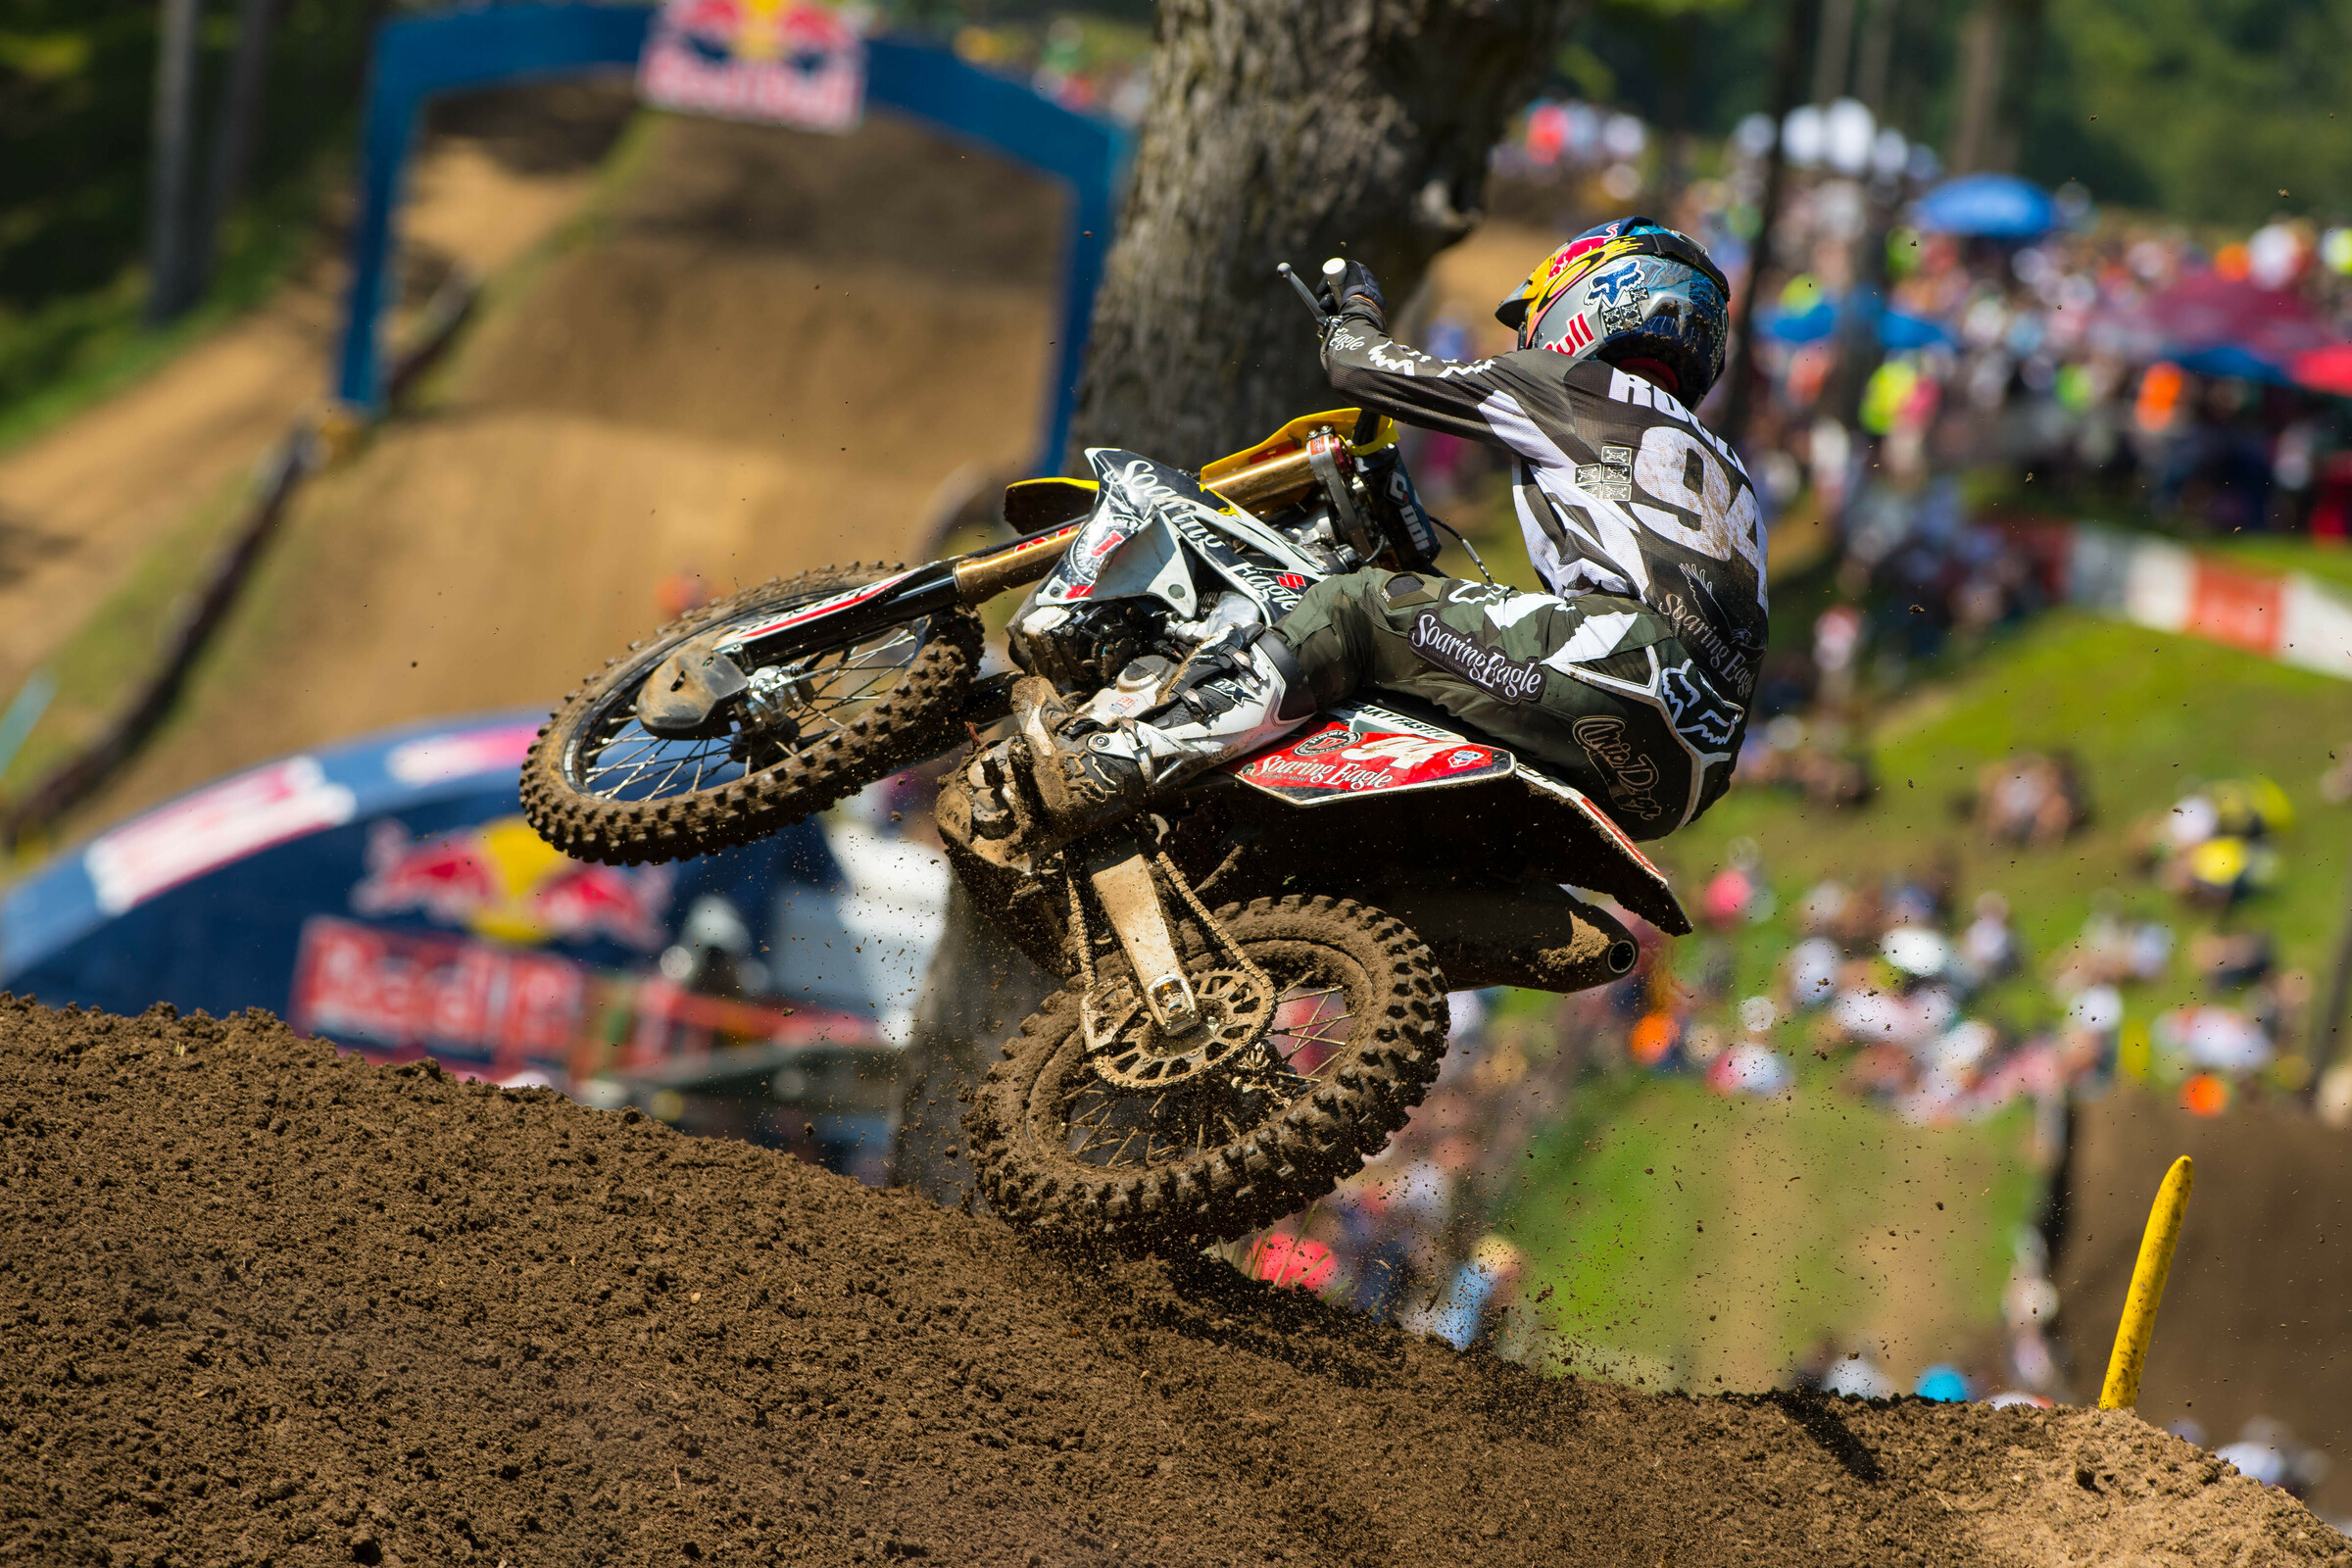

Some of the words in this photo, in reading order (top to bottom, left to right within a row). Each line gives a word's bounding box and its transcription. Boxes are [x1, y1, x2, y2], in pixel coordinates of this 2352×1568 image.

[1658, 593, 1729, 668] Soaring
[1719, 652, 1755, 699] Eagle
[1255, 755, 1334, 784] Soaring
[1323, 762, 1395, 791] Eagle
